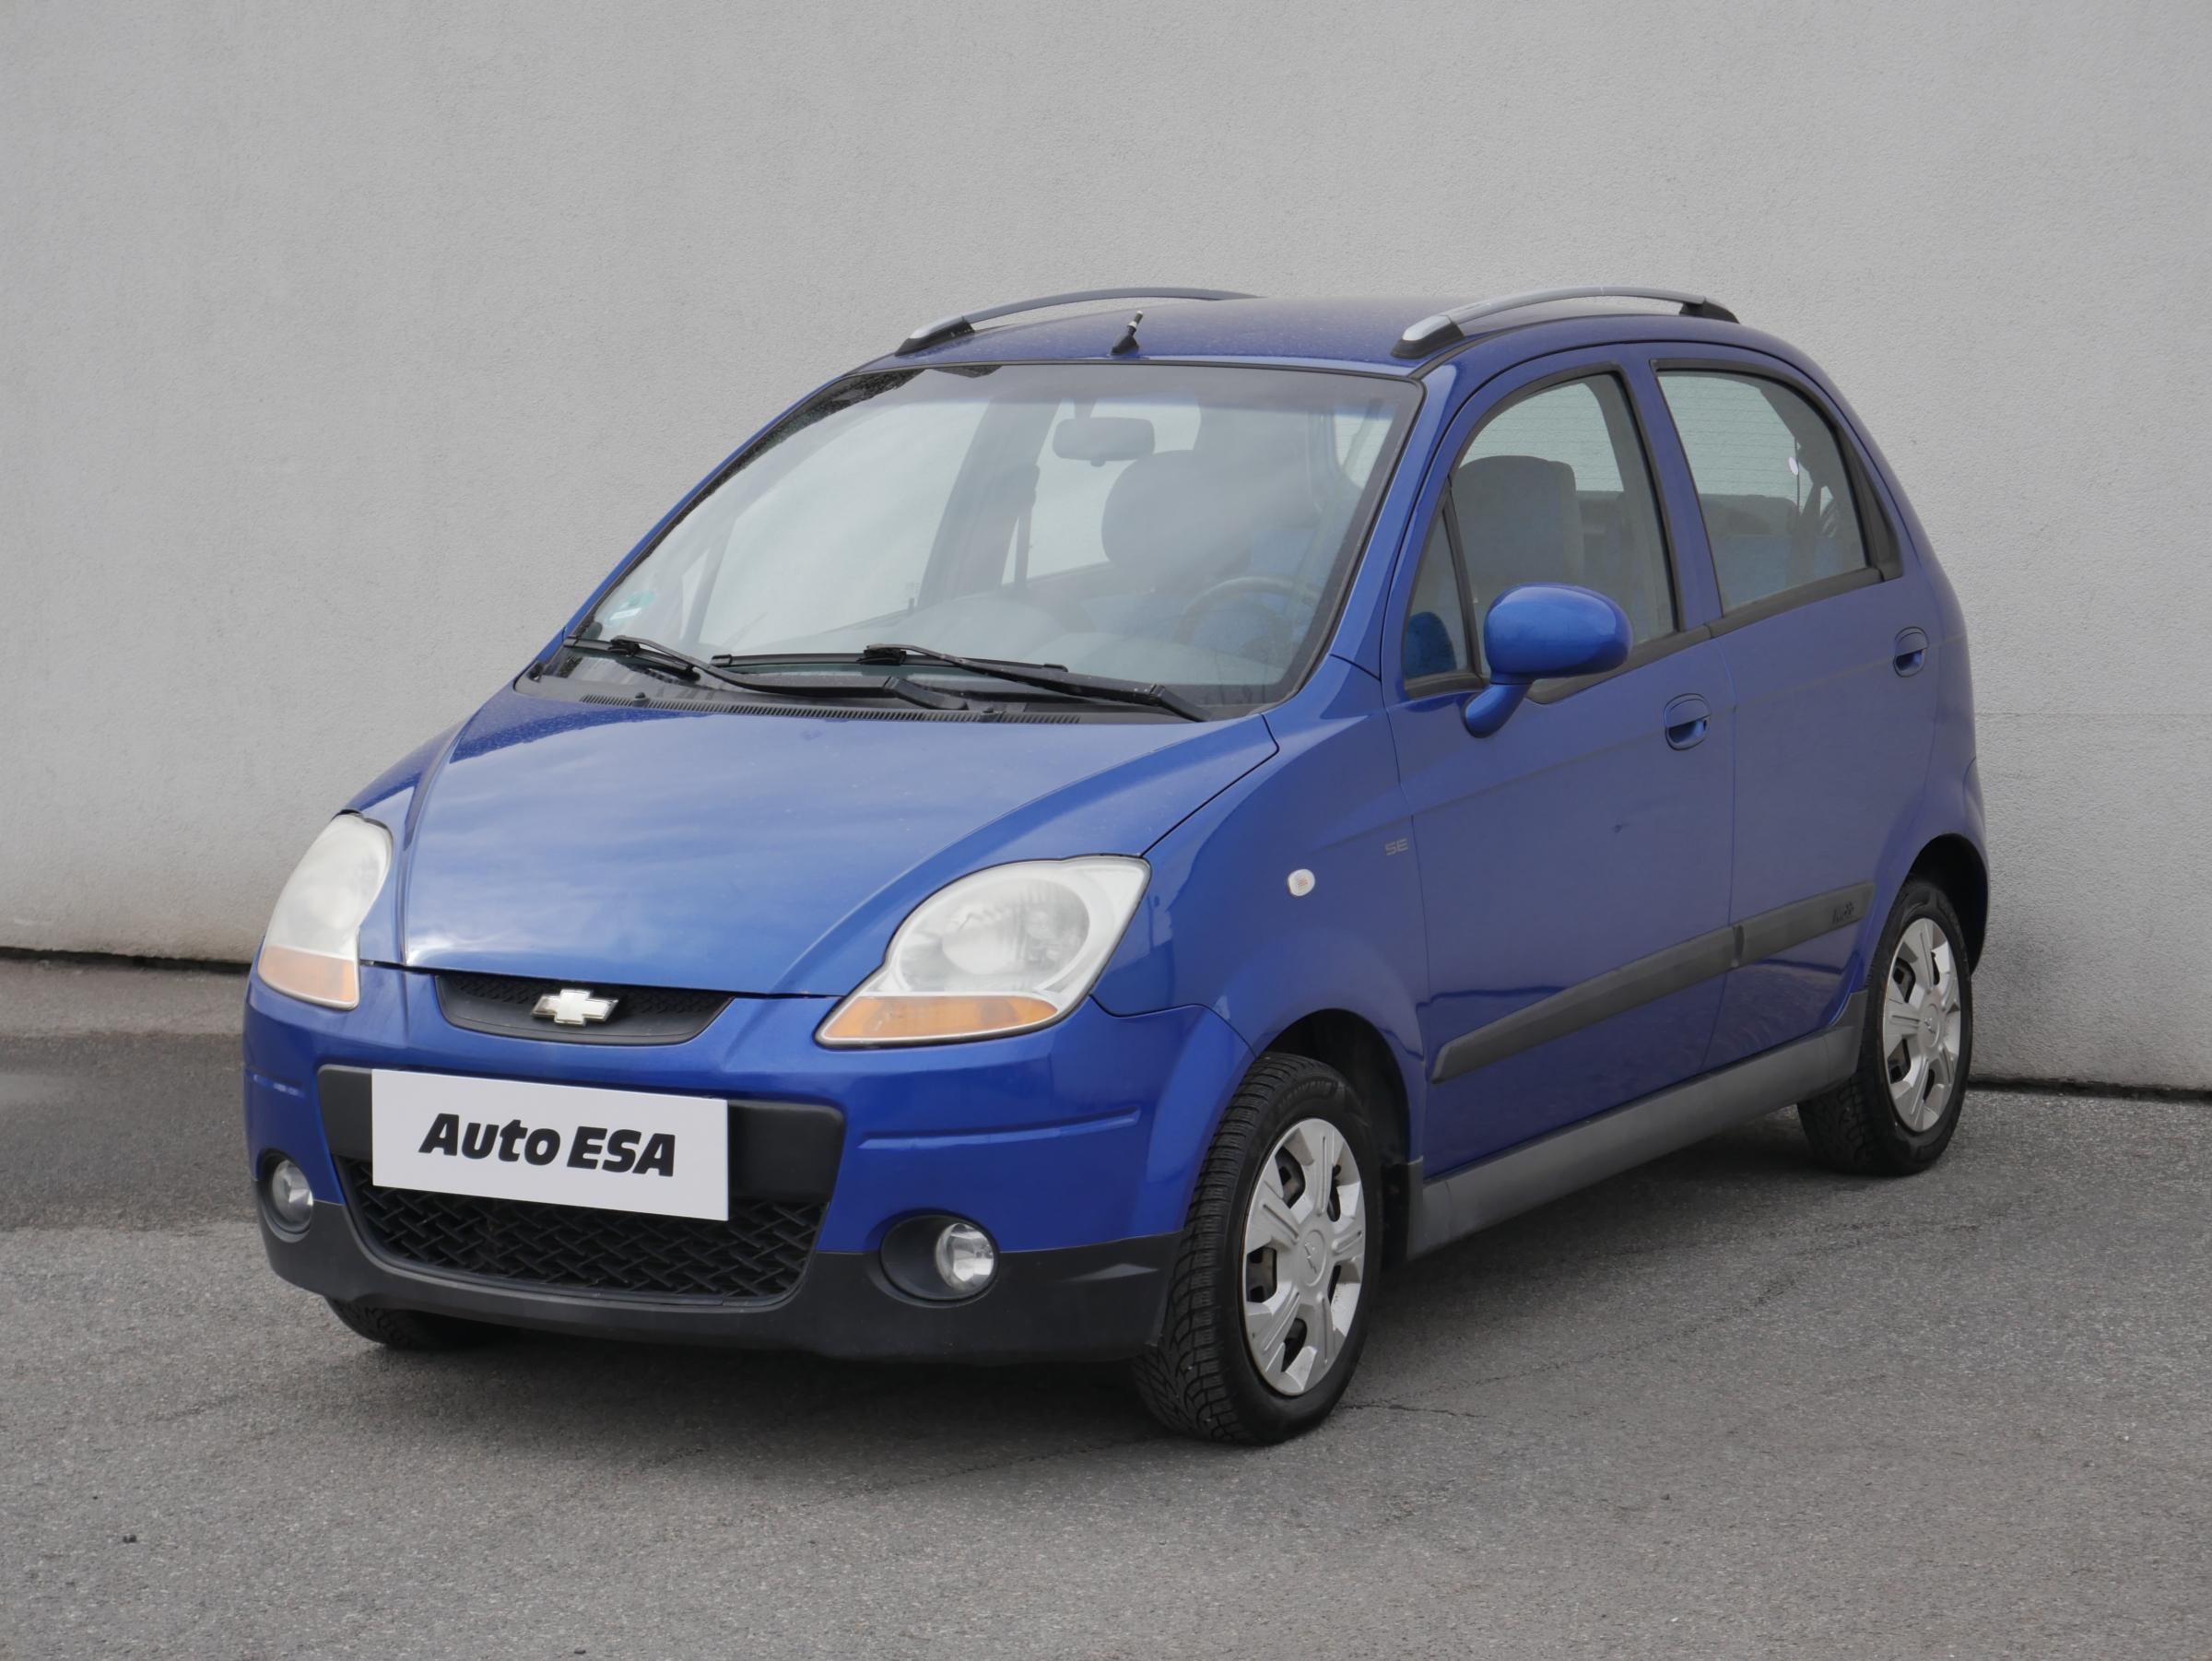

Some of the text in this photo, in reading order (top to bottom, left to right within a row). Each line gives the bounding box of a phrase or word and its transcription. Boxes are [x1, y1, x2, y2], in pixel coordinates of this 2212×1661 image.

[1385, 838, 1408, 855] SE
[418, 1113, 676, 1177] Auto ESA
